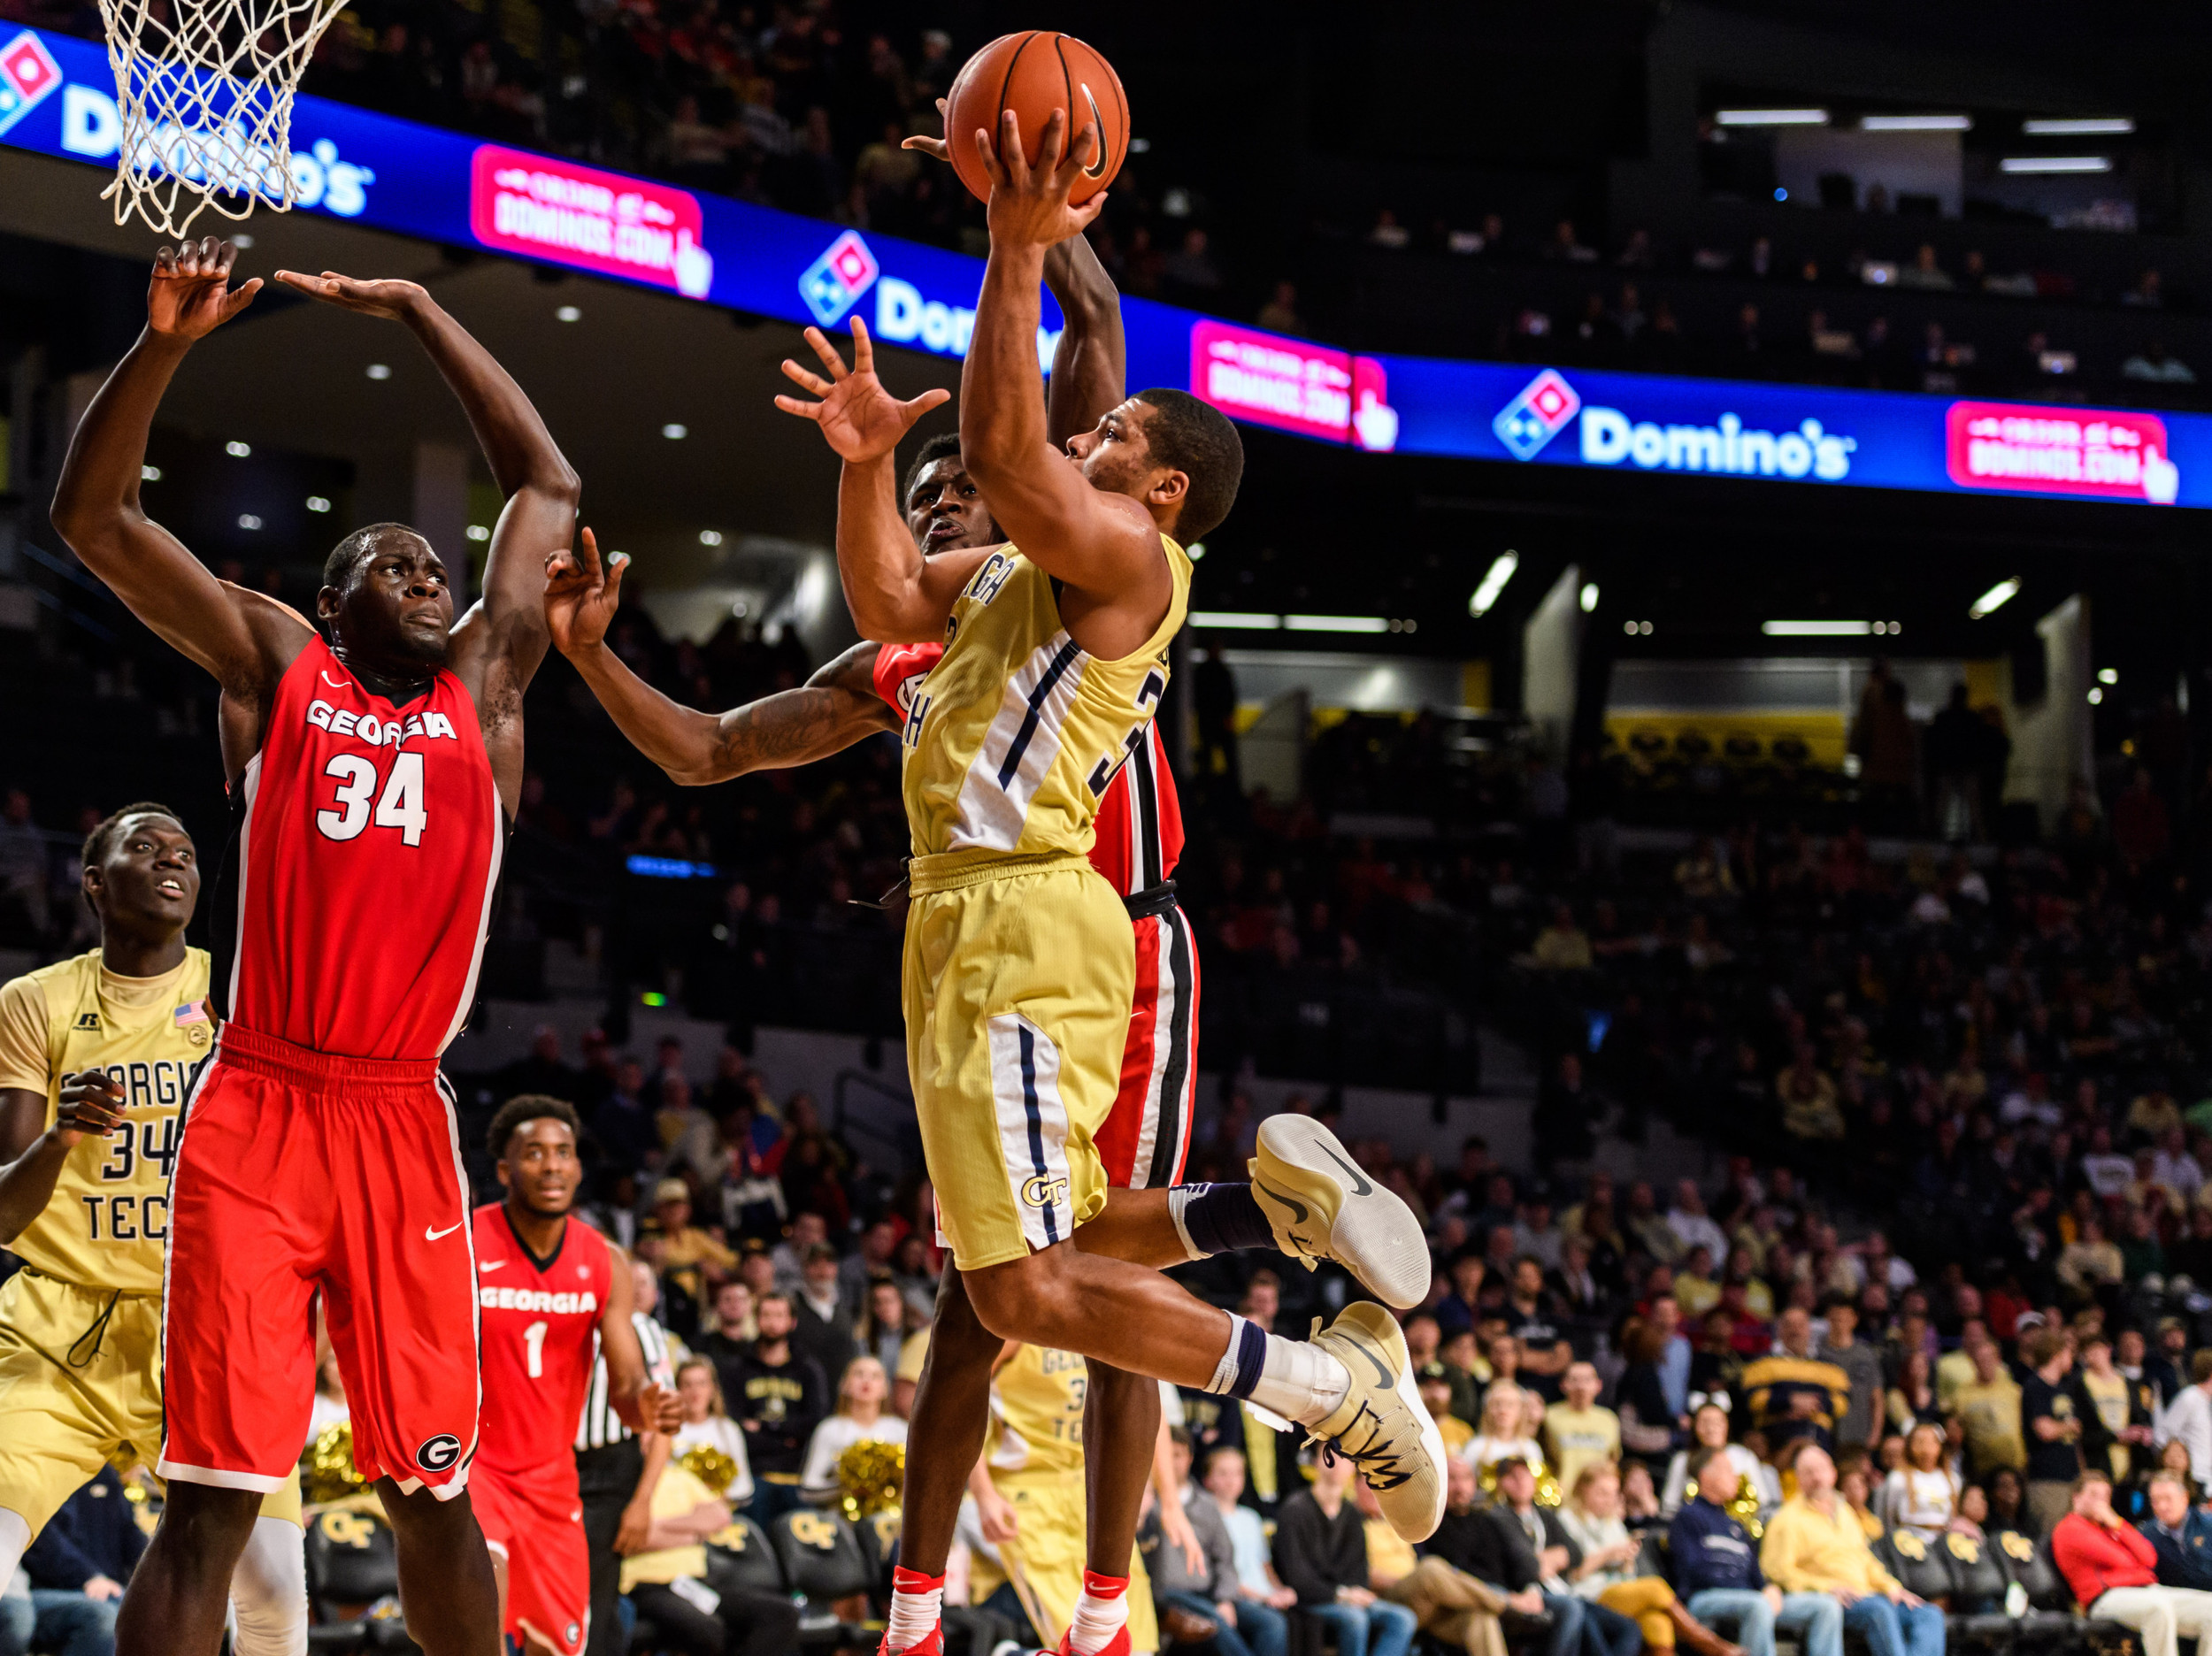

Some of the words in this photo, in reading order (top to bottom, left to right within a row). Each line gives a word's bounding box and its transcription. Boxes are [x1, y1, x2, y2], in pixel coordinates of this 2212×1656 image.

[1579, 405, 1851, 481] Domino's
[306, 699, 457, 751] GEORGIA
[317, 752, 427, 847] 34
[60, 1061, 199, 1107] ORGI
[103, 1116, 179, 1179] 34
[83, 1195, 167, 1240] TEC
[480, 1287, 597, 1315] GEORGIA
[524, 1321, 549, 1378] 1
